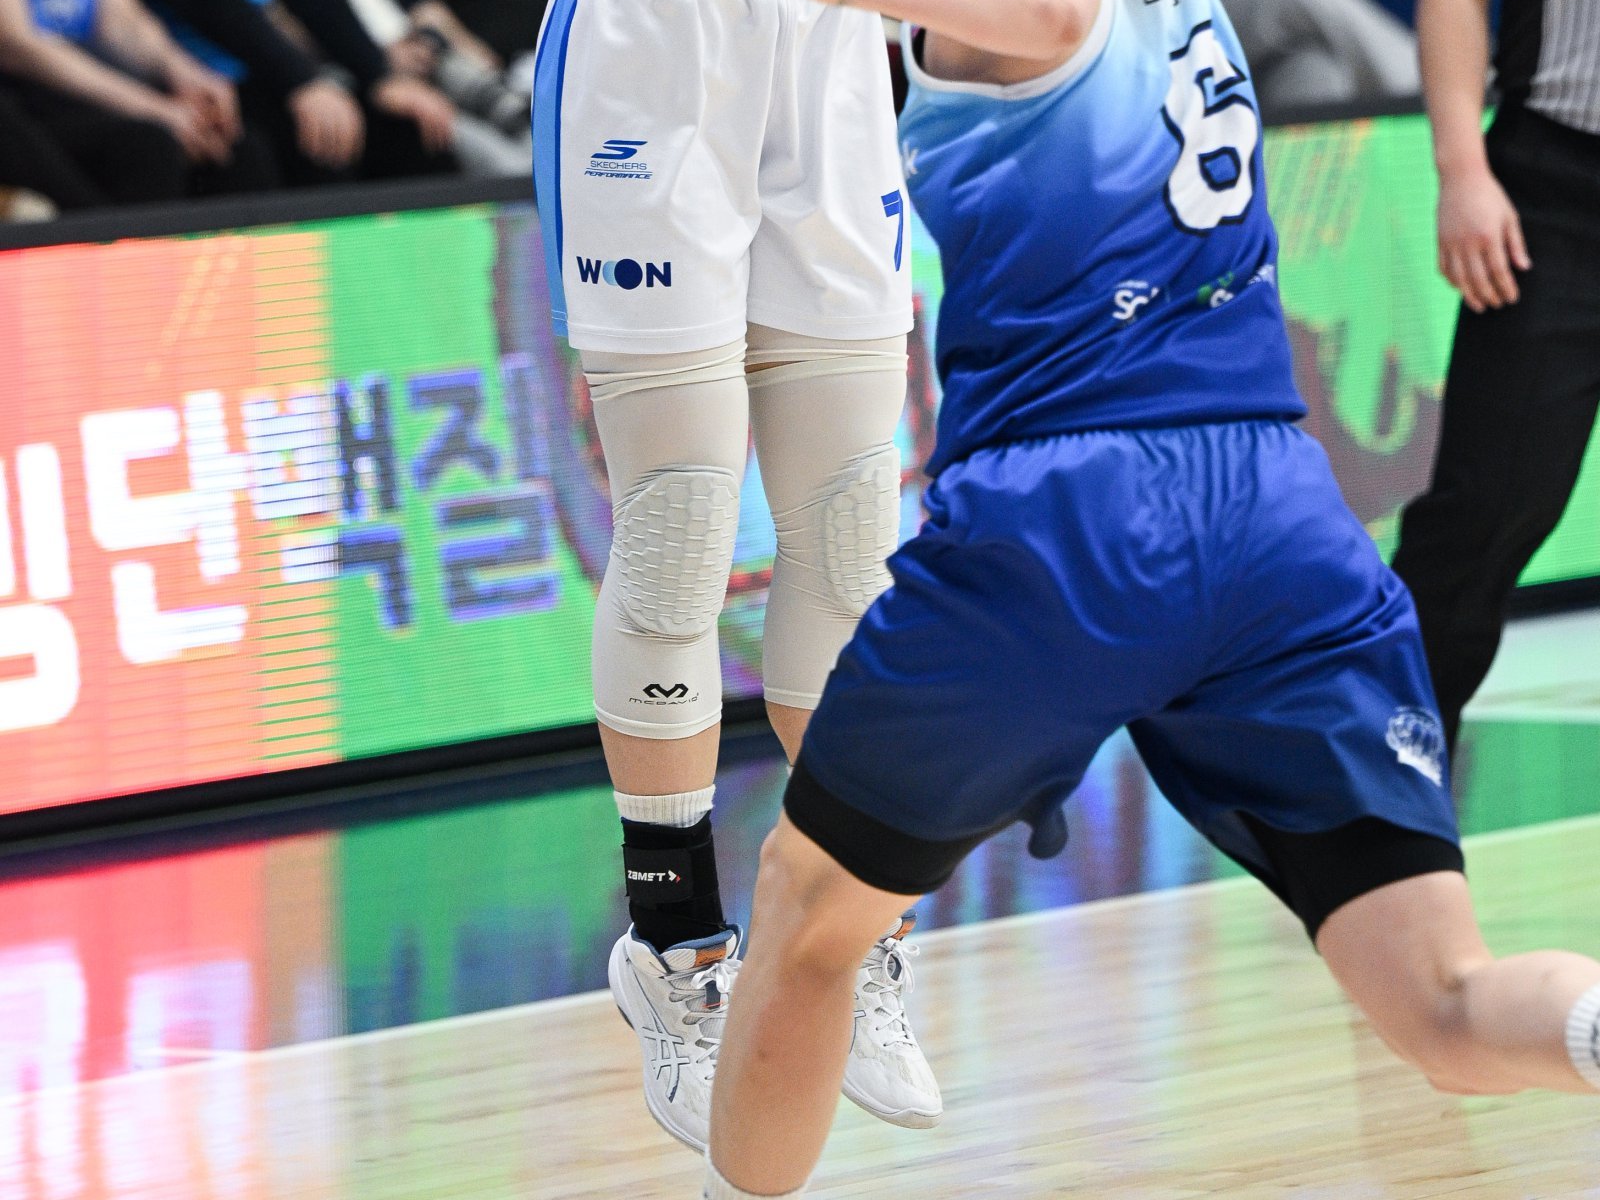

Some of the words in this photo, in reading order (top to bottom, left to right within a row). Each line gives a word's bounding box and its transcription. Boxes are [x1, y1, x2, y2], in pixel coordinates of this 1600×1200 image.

[590, 160, 648, 171] SKECHERS
[584, 170, 653, 180] PERFORMANCE
[880, 188, 904, 272] 7
